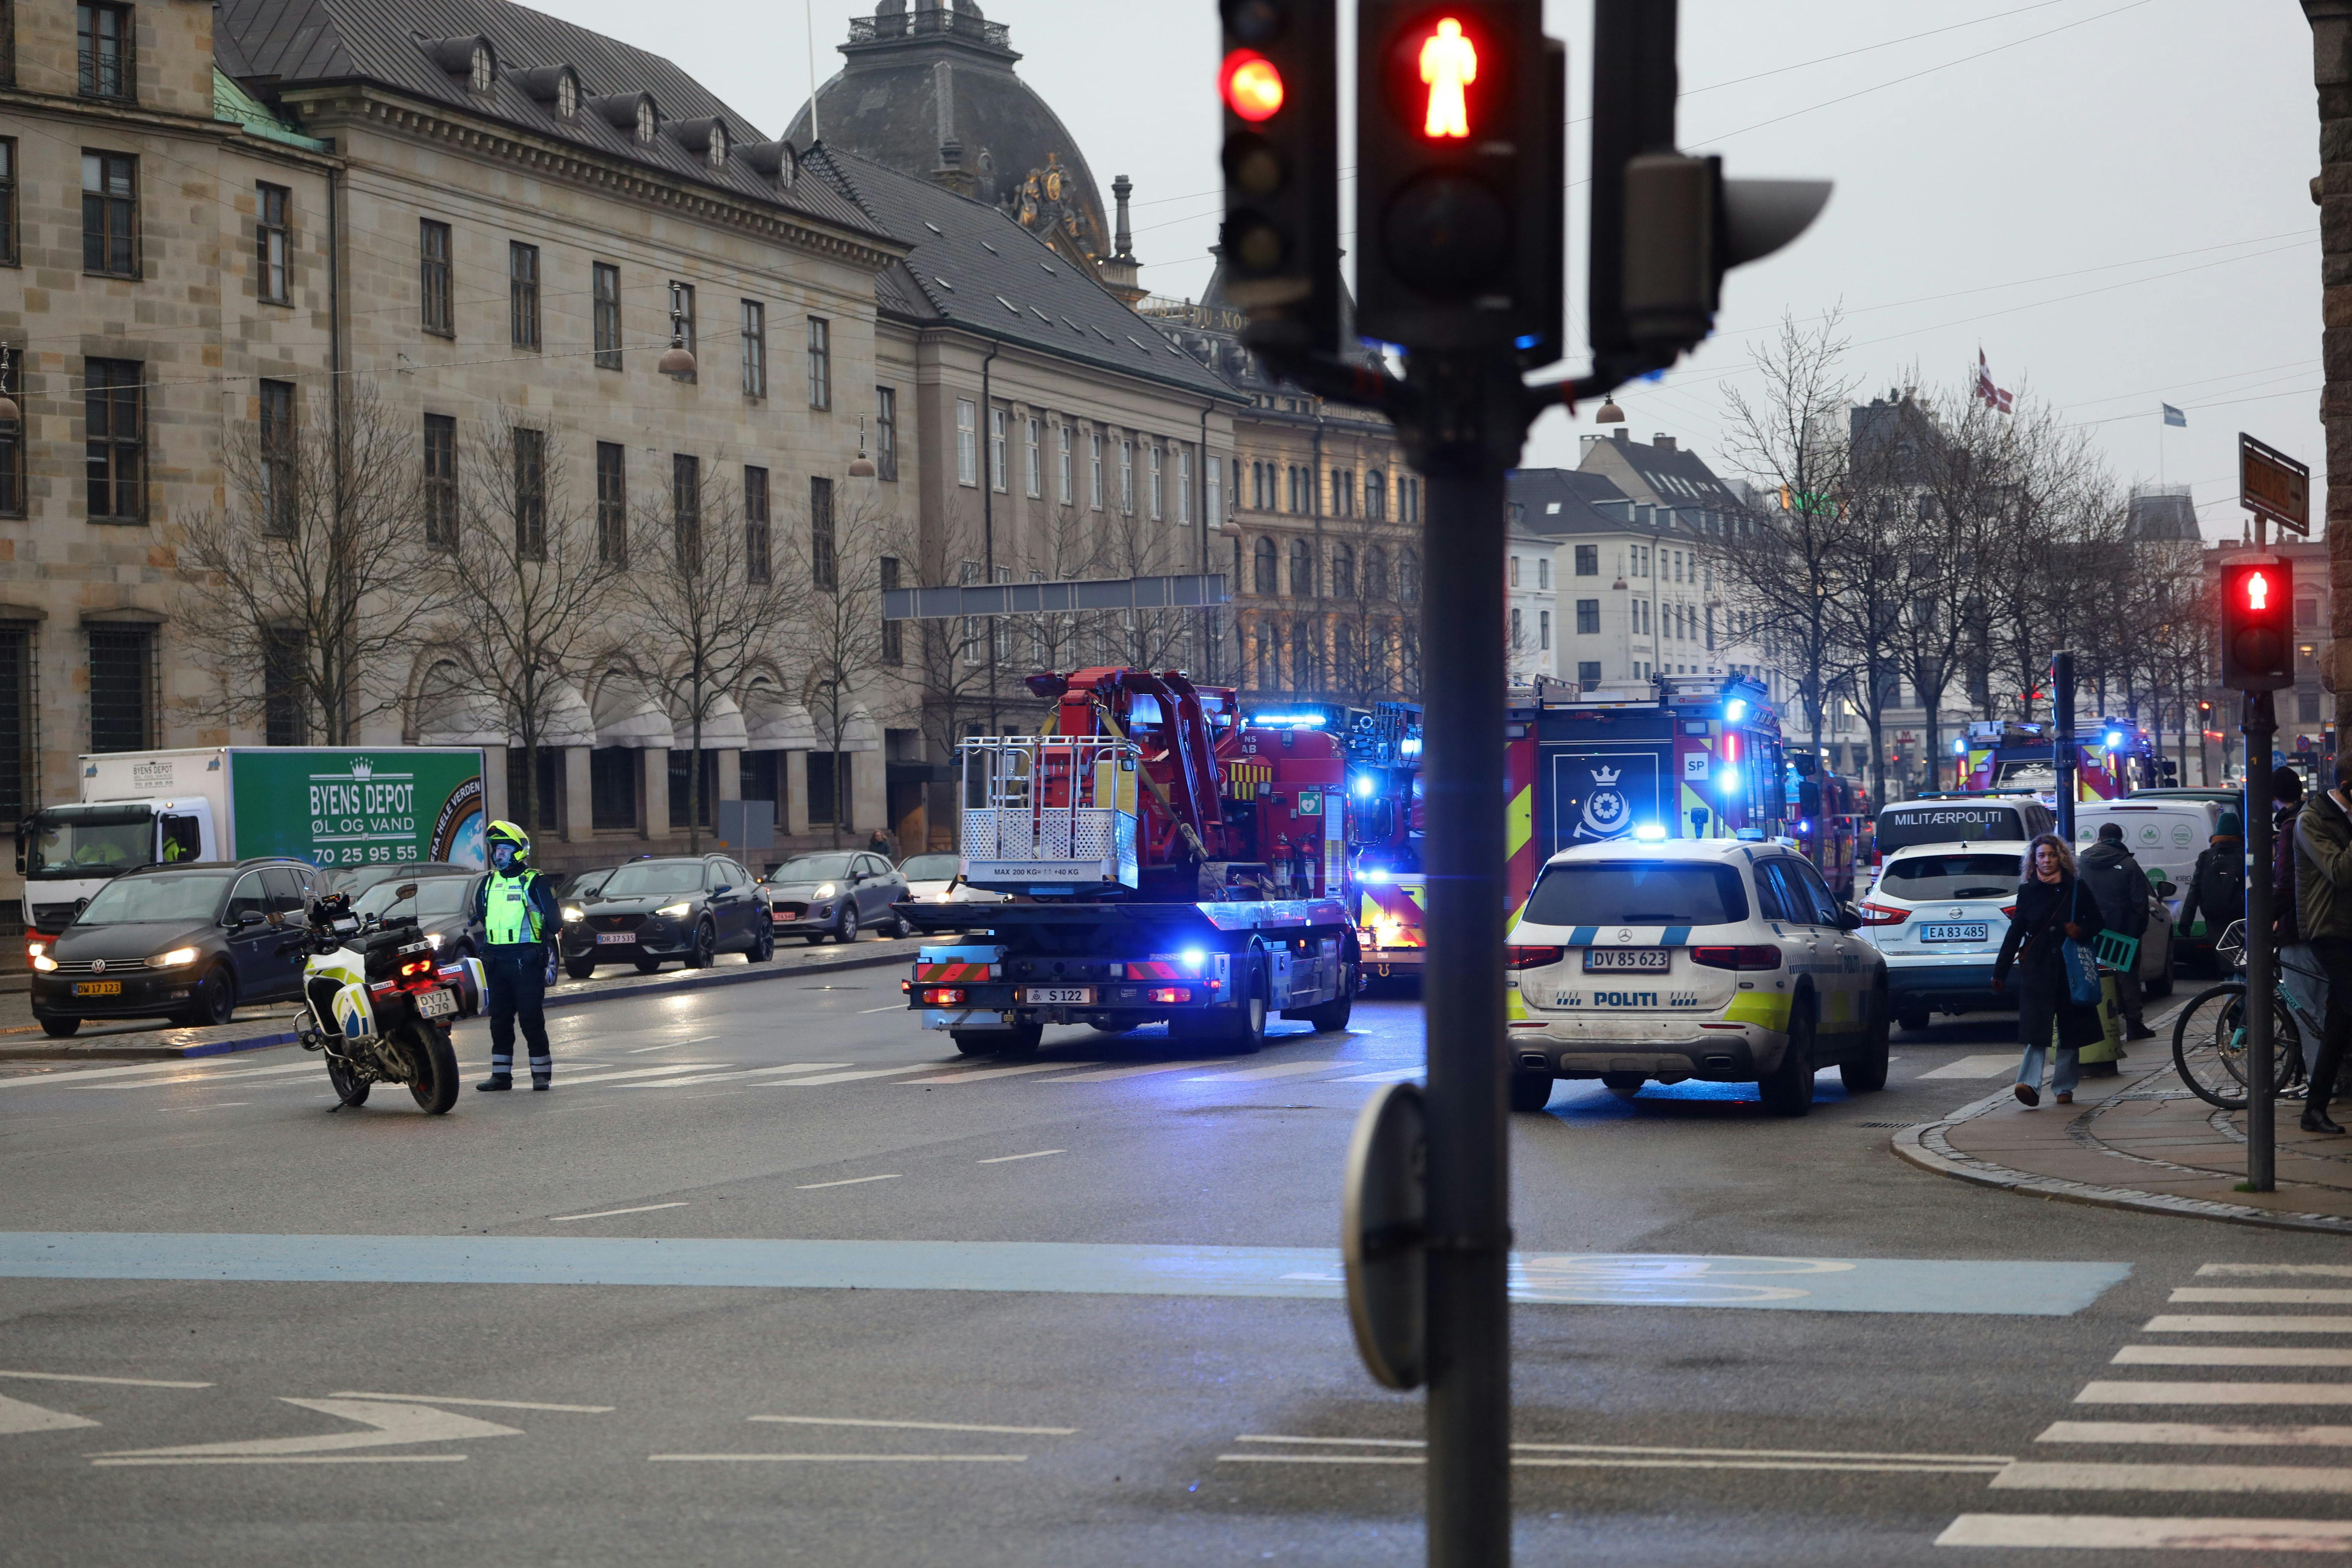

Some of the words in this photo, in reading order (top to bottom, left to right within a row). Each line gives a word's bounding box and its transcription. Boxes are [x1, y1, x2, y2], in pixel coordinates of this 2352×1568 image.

[1193, 307, 1212, 325] DU
[133, 766, 152, 775] BYENS
[154, 765, 172, 774] DEPOT
[1688, 761, 1704, 771] SP
[309, 785, 360, 816] BYENS
[365, 784, 414, 814] DEPOT
[436, 803, 453, 835] HELE
[451, 781, 480, 807] VERDEN
[1894, 811, 2001, 826] MILITÆRPOLITI
[311, 819, 335, 835] ØL
[340, 819, 364, 832] OG
[370, 817, 415, 831] VAND
[312, 848, 335, 864] 70
[341, 848, 363, 863] 25
[369, 847, 390, 861] 95
[397, 845, 418, 861] 55
[1930, 927, 1945, 938] EA
[1947, 927, 1960, 937] 83
[1964, 926, 1984, 937] 485
[1594, 952, 1615, 966] DV
[1618, 952, 1635, 966] 85
[1639, 952, 1666, 966] 623
[78, 985, 89, 993] DW
[92, 984, 101, 993] 17
[104, 984, 119, 992] 123
[1049, 990, 1057, 1001] S
[1061, 990, 1082, 1001] 122
[1594, 992, 1658, 1006] POLITI
[2276, 985, 2298, 1011] PINNACLE
[428, 1002, 449, 1015] 279
